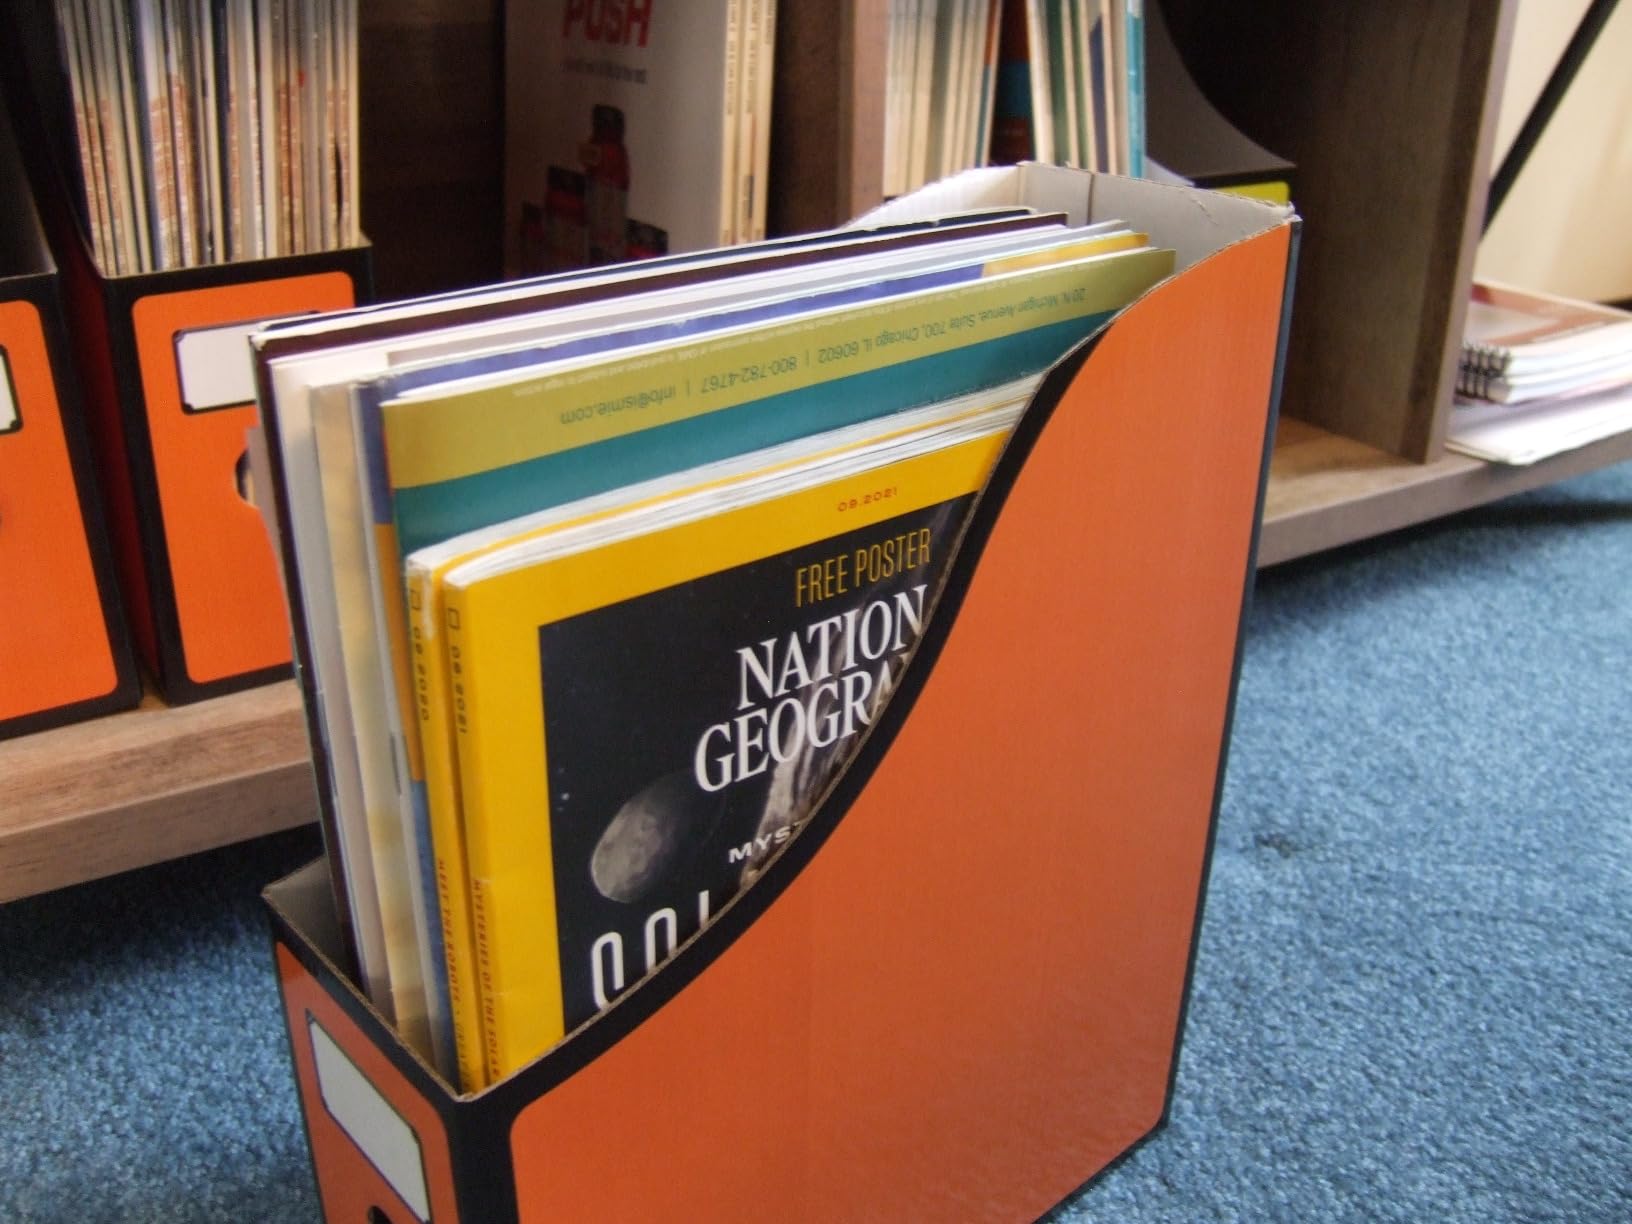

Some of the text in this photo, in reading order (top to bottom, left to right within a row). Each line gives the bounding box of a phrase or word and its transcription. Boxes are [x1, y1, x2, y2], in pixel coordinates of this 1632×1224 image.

[949, 315, 976, 331] Suite
[1018, 296, 1057, 313] Michigan
[818, 339, 860, 364] 60602
[875, 325, 919, 346] Chicago
[701, 356, 798, 394] 800-782-4767
[560, 383, 676, 425] info@ismie.com
[796, 528, 932, 607] FREE POSTER
[736, 584, 928, 711] NATION
[694, 652, 910, 792] GEOGRA
[729, 822, 799, 863] MYS
